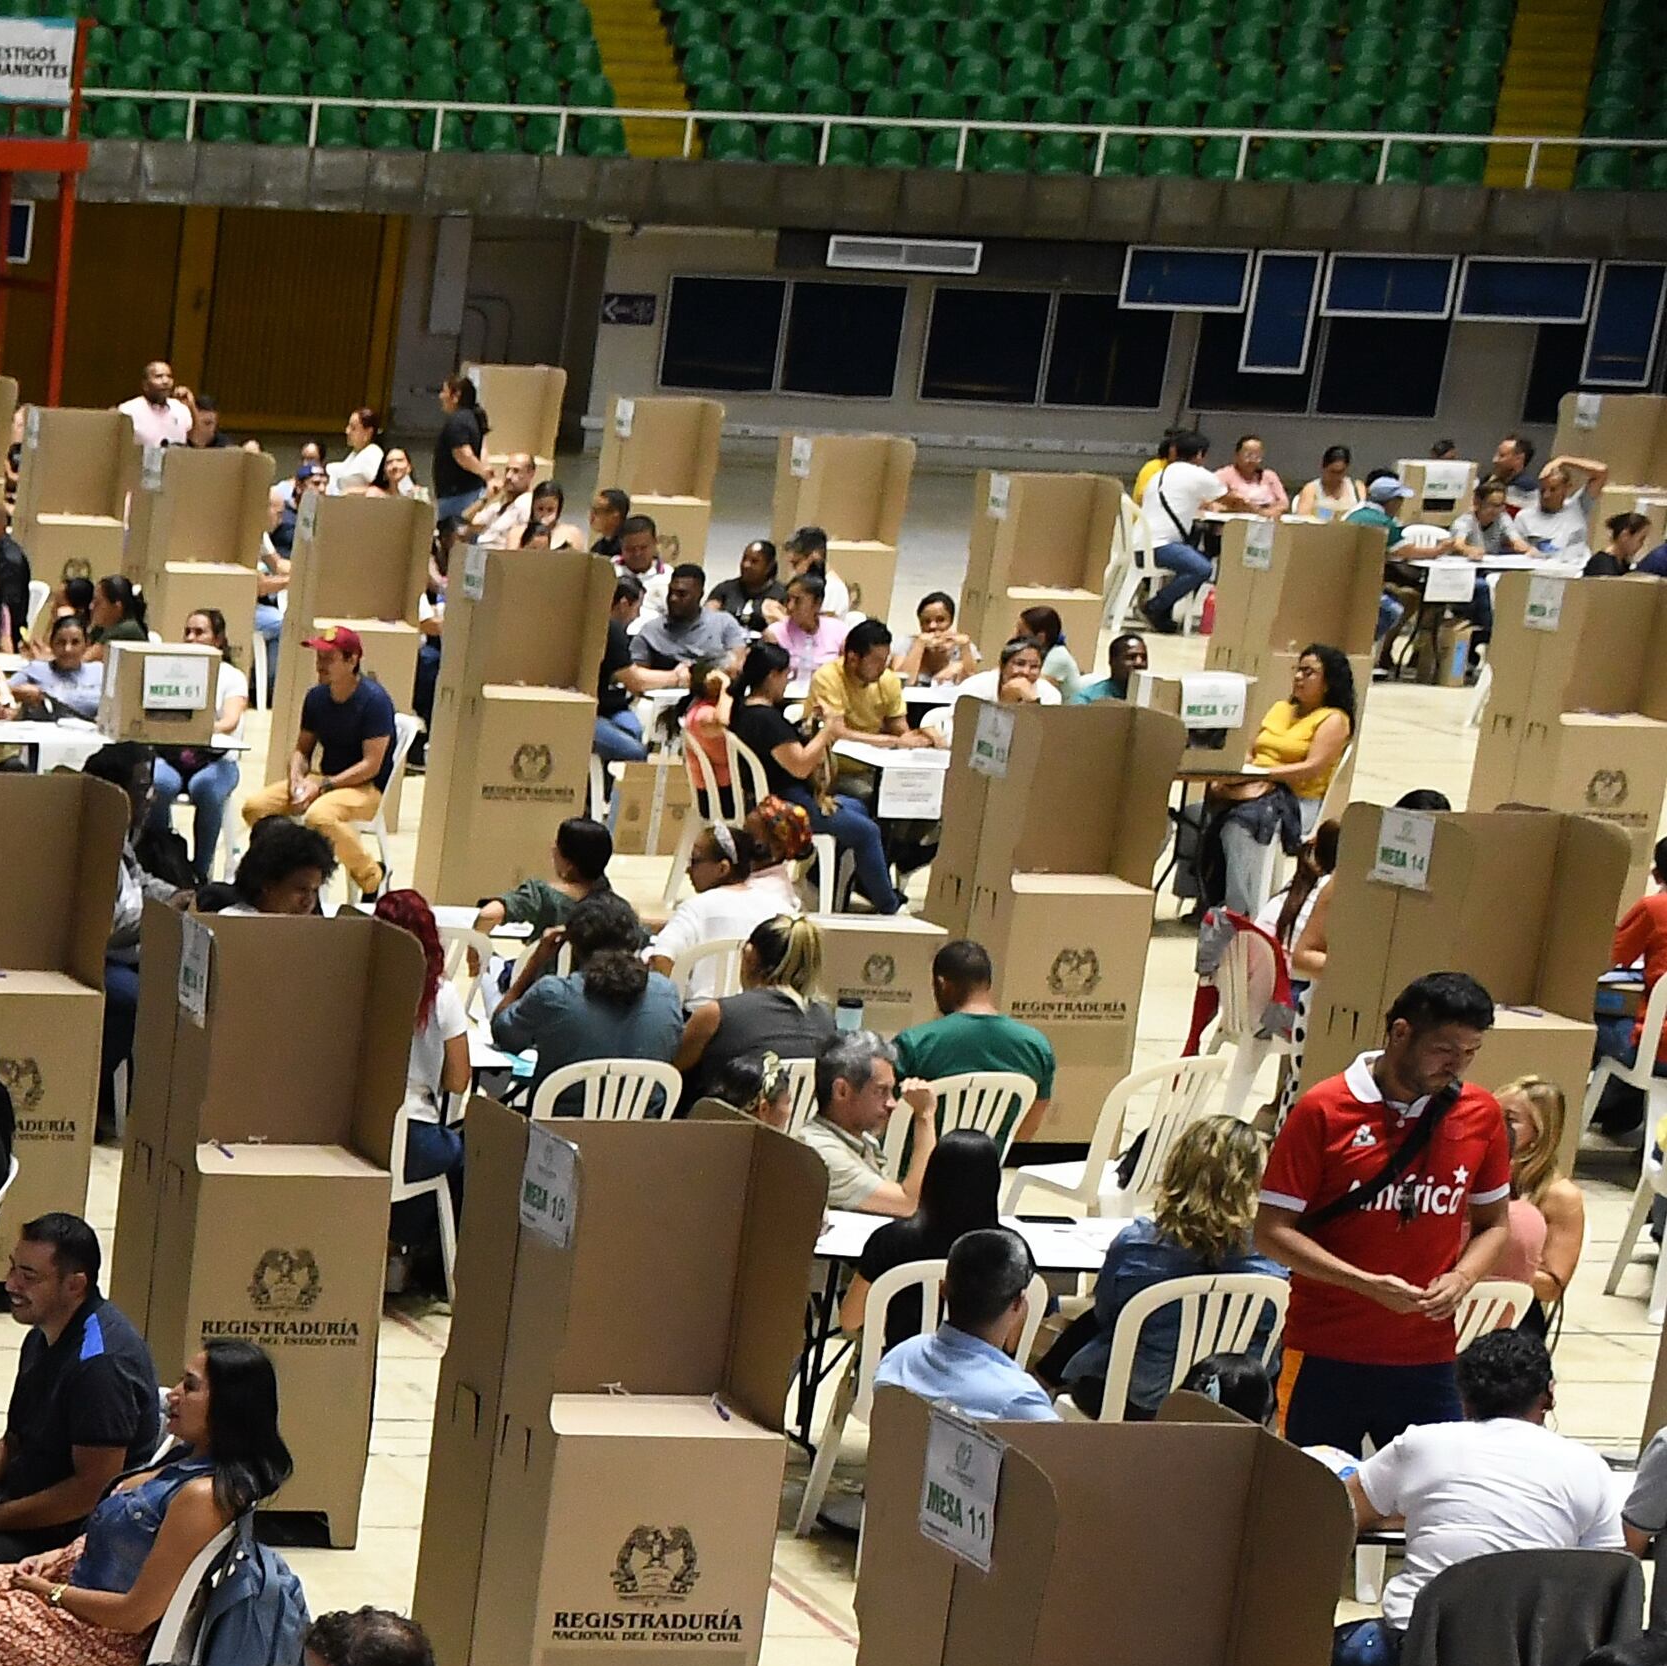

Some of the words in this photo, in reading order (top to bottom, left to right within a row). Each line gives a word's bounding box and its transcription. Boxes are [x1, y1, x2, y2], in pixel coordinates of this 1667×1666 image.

[149, 685, 180, 697] MESA
[184, 685, 201, 698] 61
[1186, 705, 1217, 716] MESA
[1221, 703, 1240, 717] 67
[1379, 846, 1408, 868] MESA
[1411, 855, 1425, 872] 14
[1010, 998, 1127, 1013] REGISTRADURÍA
[523, 1179, 548, 1212] MESA
[551, 1196, 566, 1222] 10
[201, 1317, 360, 1336] REGISTRADURÍA
[926, 1481, 963, 1529] MESA
[968, 1506, 986, 1540] 11
[553, 1608, 743, 1630] REGISTRADURÍA
[552, 1631, 617, 1642] NACIONAL
[622, 1631, 647, 1642] DEL
[652, 1631, 703, 1642] ESTADO
[708, 1632, 742, 1643] CIVIL
